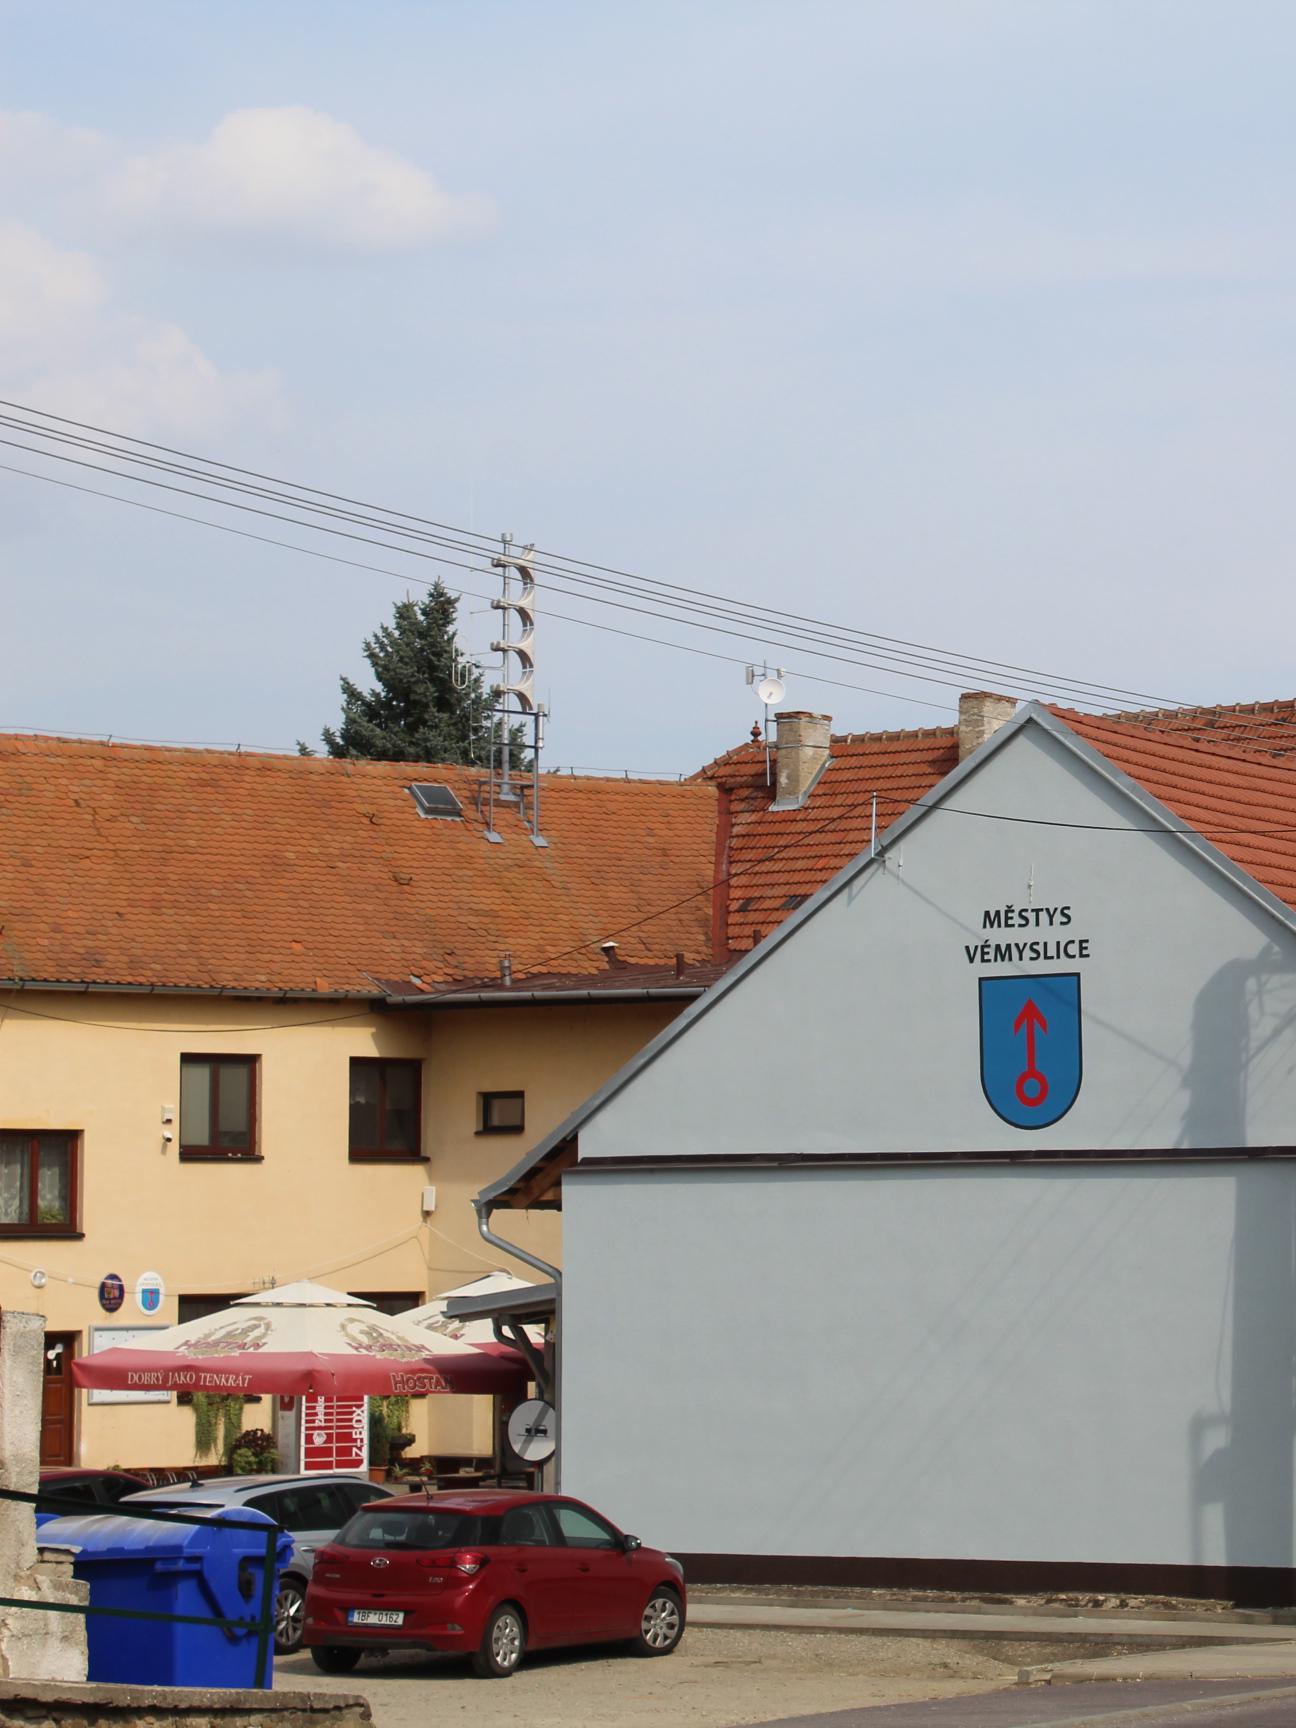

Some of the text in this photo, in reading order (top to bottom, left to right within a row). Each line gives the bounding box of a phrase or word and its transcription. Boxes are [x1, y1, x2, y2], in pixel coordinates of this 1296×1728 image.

[982, 904, 1072, 929] MĚSTYS
[964, 939, 1091, 964] VÉMYSLICE
[127, 1369, 252, 1387] DOBRÝ JAKO TENKRÁT
[352, 1406, 365, 1459] Z-BOX
[356, 1611, 400, 1623] 1BF 0162
